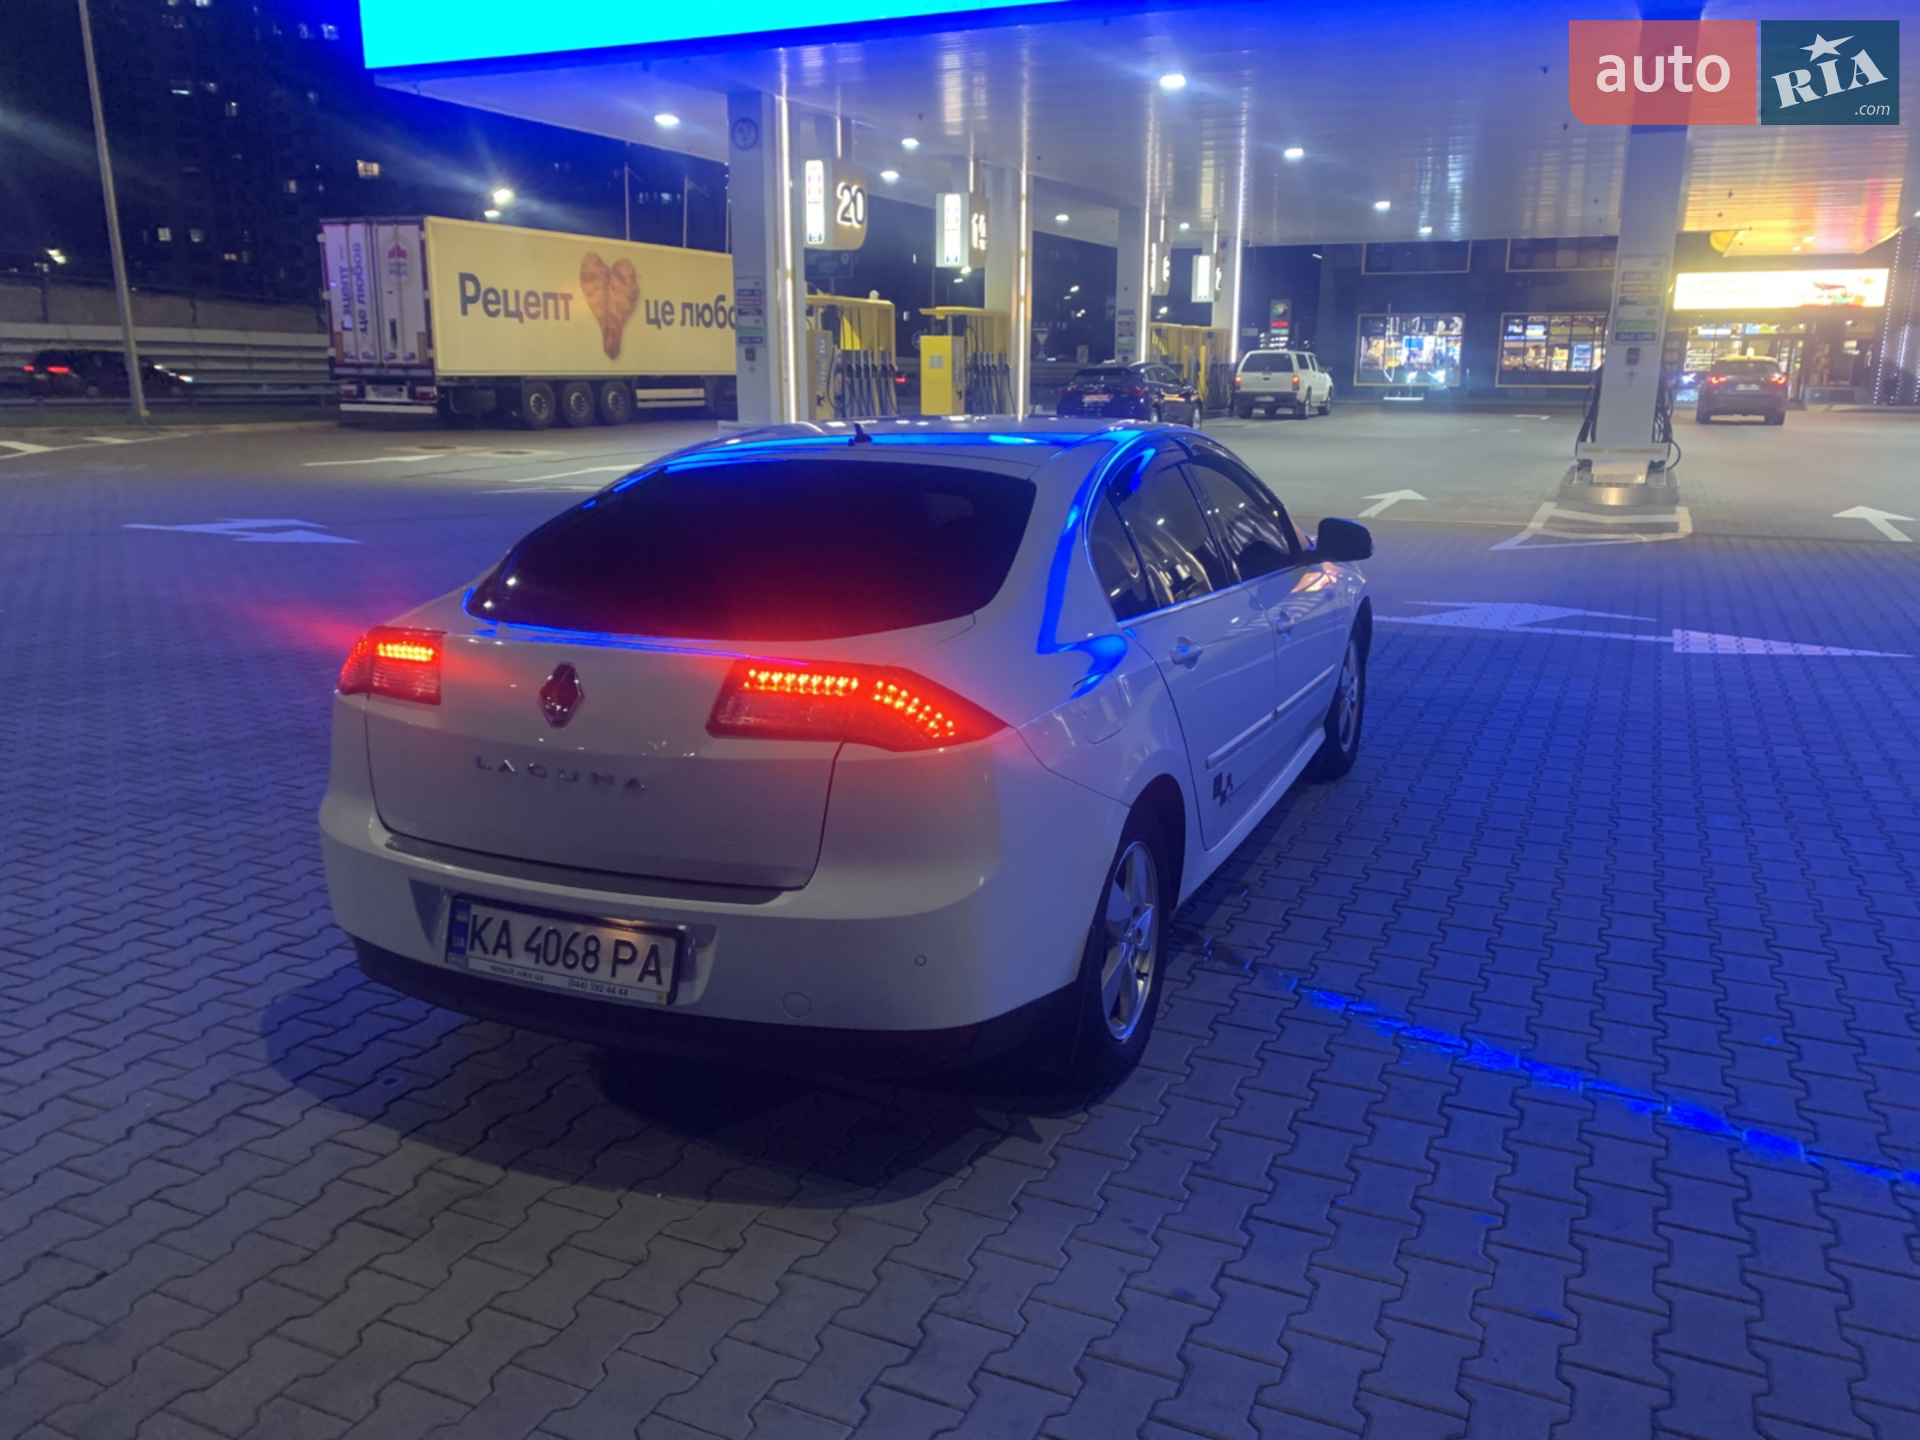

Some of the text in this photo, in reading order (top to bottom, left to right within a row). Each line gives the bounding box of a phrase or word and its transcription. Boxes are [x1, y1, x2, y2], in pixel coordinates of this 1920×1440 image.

[836, 181, 866, 229] 20
[458, 271, 574, 325] Рецепт
[645, 299, 675, 330] це
[475, 756, 646, 791] LAGUNA
[524, 926, 601, 973] 4068
